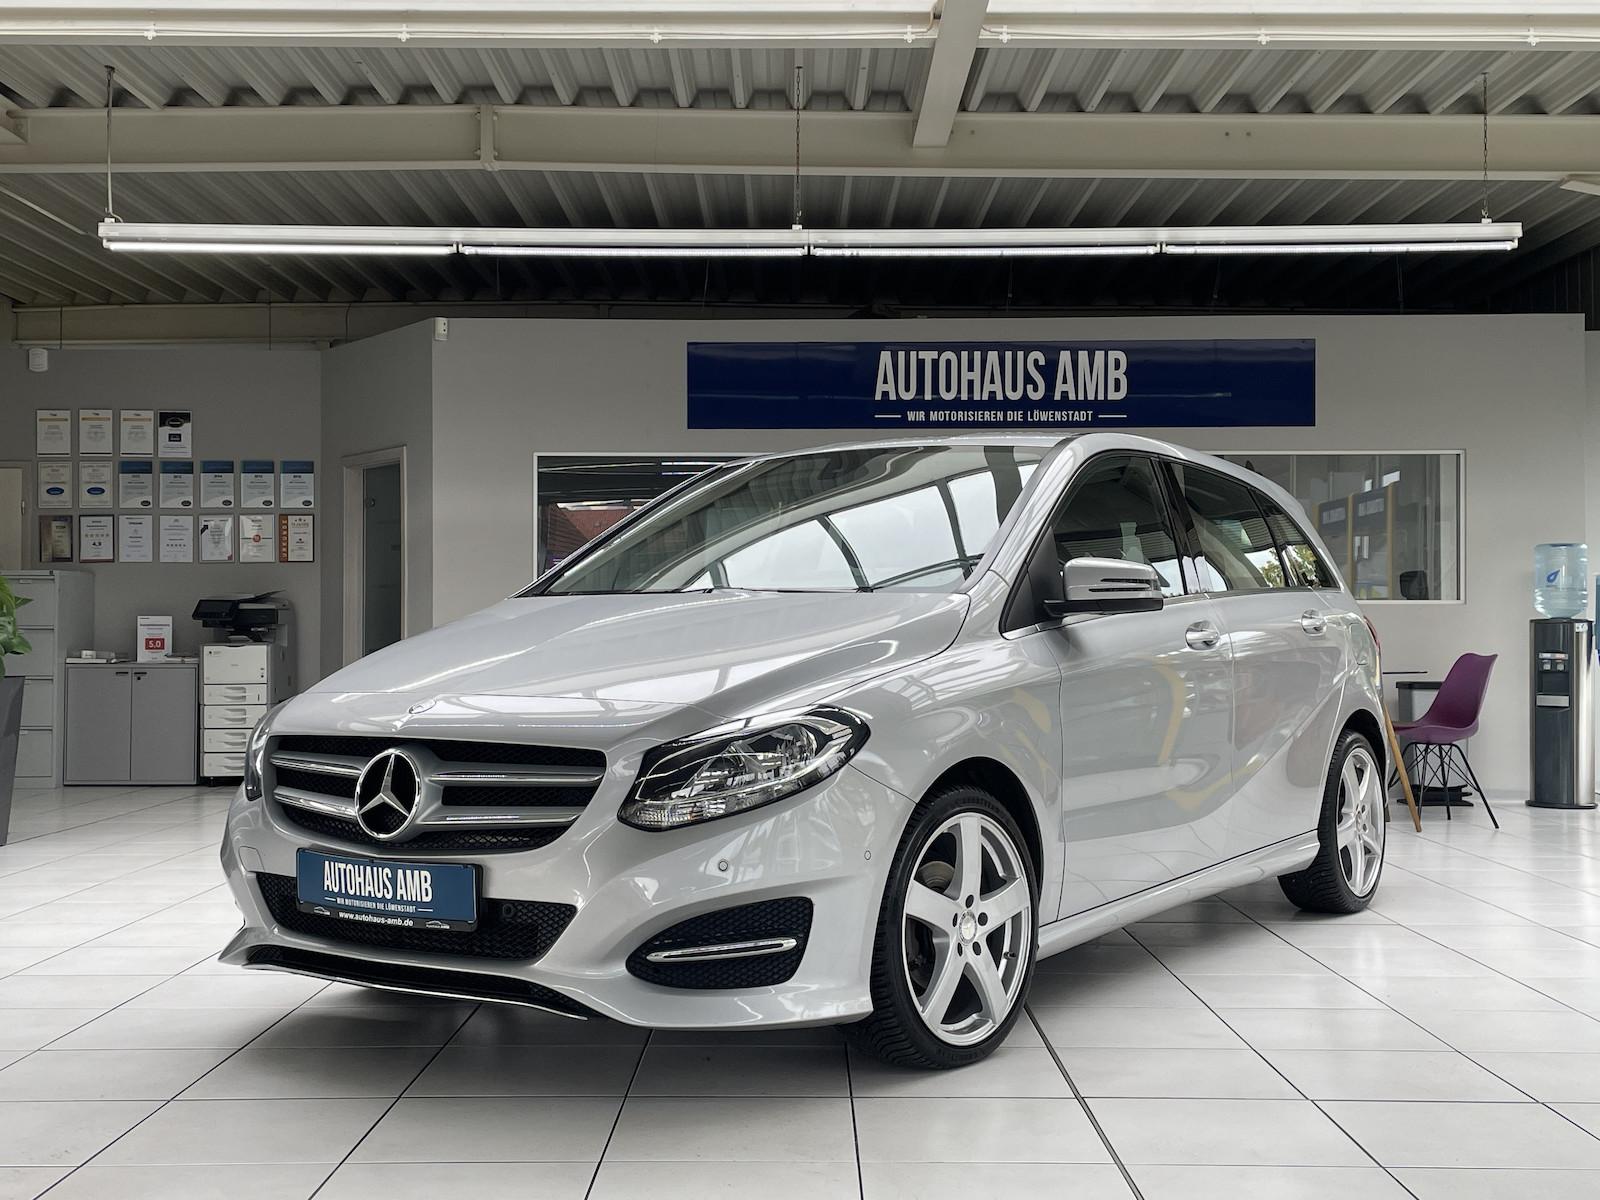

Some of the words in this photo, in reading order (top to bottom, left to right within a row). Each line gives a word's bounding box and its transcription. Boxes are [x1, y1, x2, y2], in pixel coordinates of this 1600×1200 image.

[874, 349, 1046, 401] AUTOHAUS
[1053, 349, 1128, 401] AMB
[906, 410, 926, 422] WIR
[929, 410, 1004, 422] MOTORISIEREN
[1006, 410, 1024, 422] DIE
[1027, 409, 1094, 422] LÖWENSTADT
[148, 640, 162, 649] 5.0
[324, 861, 393, 900] AUTOHAUS
[396, 868, 433, 903] AMB
[336, 897, 345, 905] WIR
[376, 902, 385, 910] DIE
[338, 911, 414, 926] www.autohaus-amb.de
